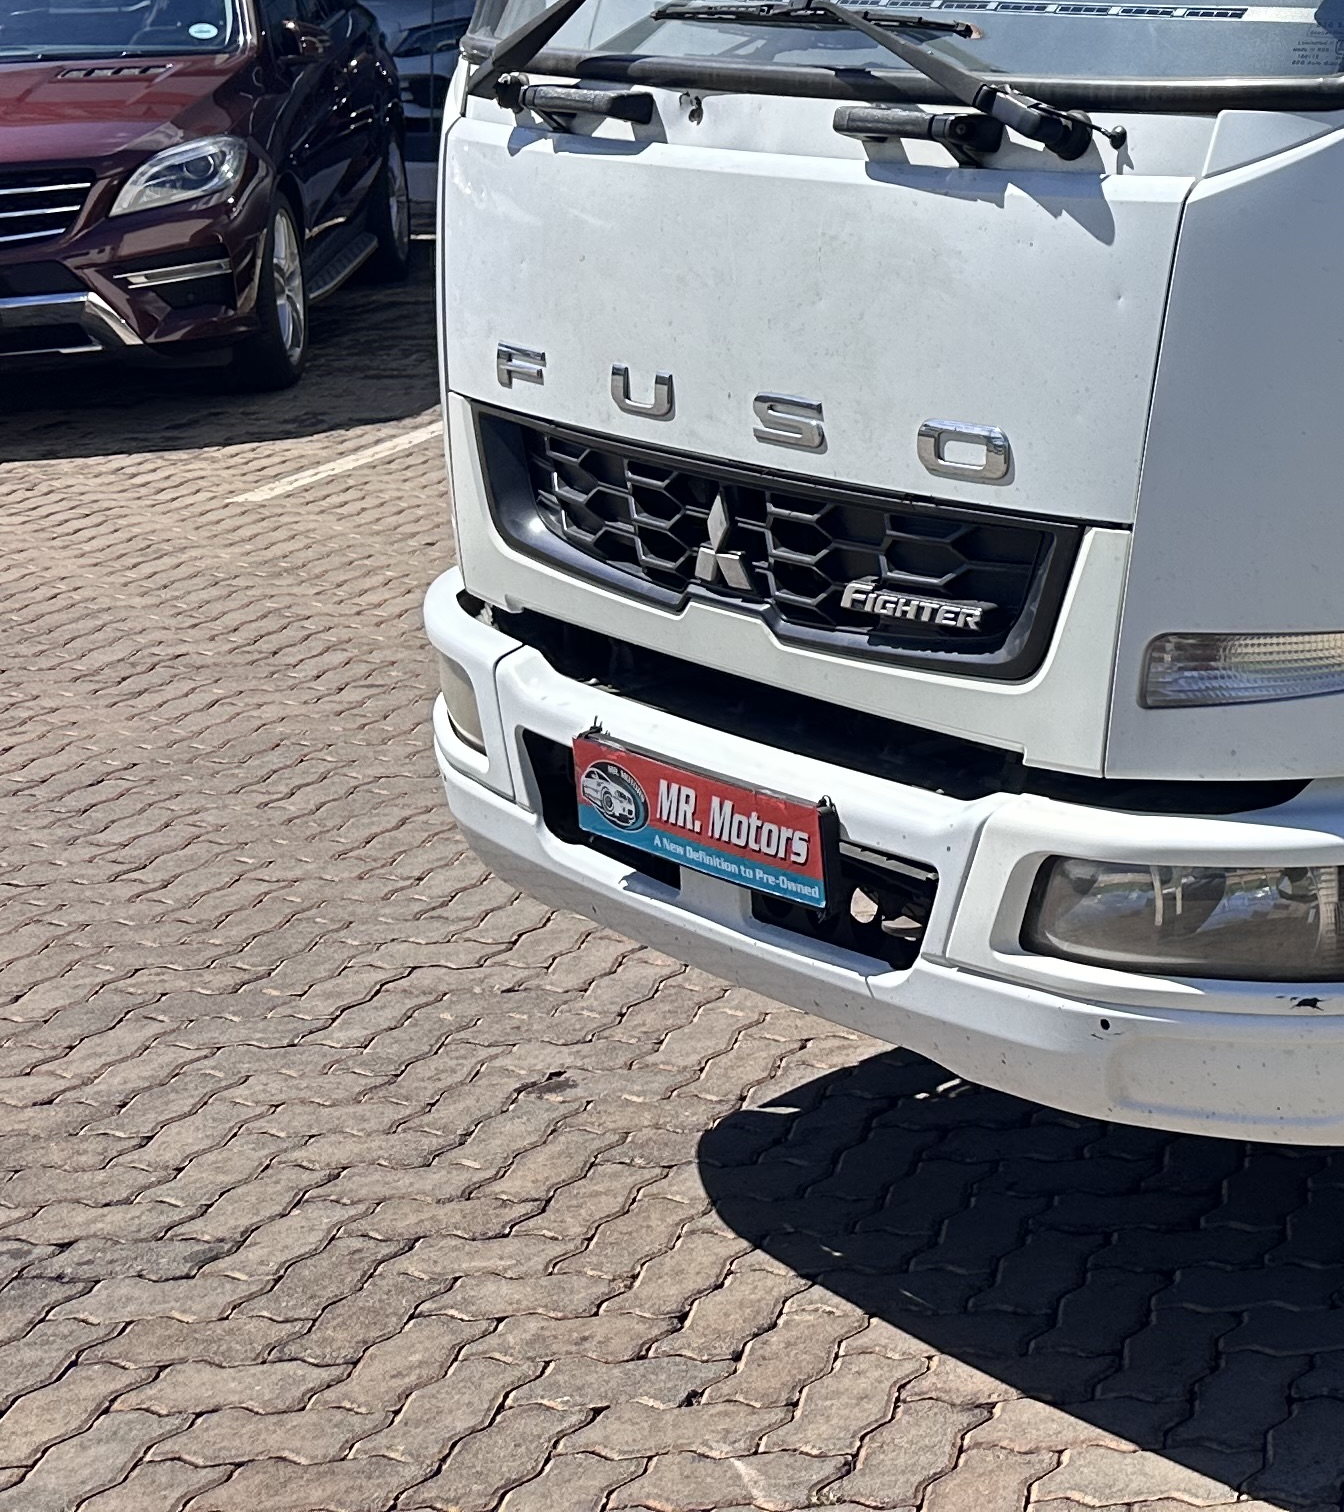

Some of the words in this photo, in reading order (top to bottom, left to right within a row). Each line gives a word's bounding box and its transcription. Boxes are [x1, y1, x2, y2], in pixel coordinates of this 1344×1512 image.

[496, 340, 1014, 483] FUSO
[839, 579, 984, 631] FIGHTER
[656, 779, 702, 833] MR.
[707, 795, 809, 864] Motors
[653, 835, 661, 847] A
[663, 838, 684, 856] New
[686, 846, 739, 875] Definition
[740, 865, 753, 879] to
[755, 868, 819, 898] Pre-Owned
